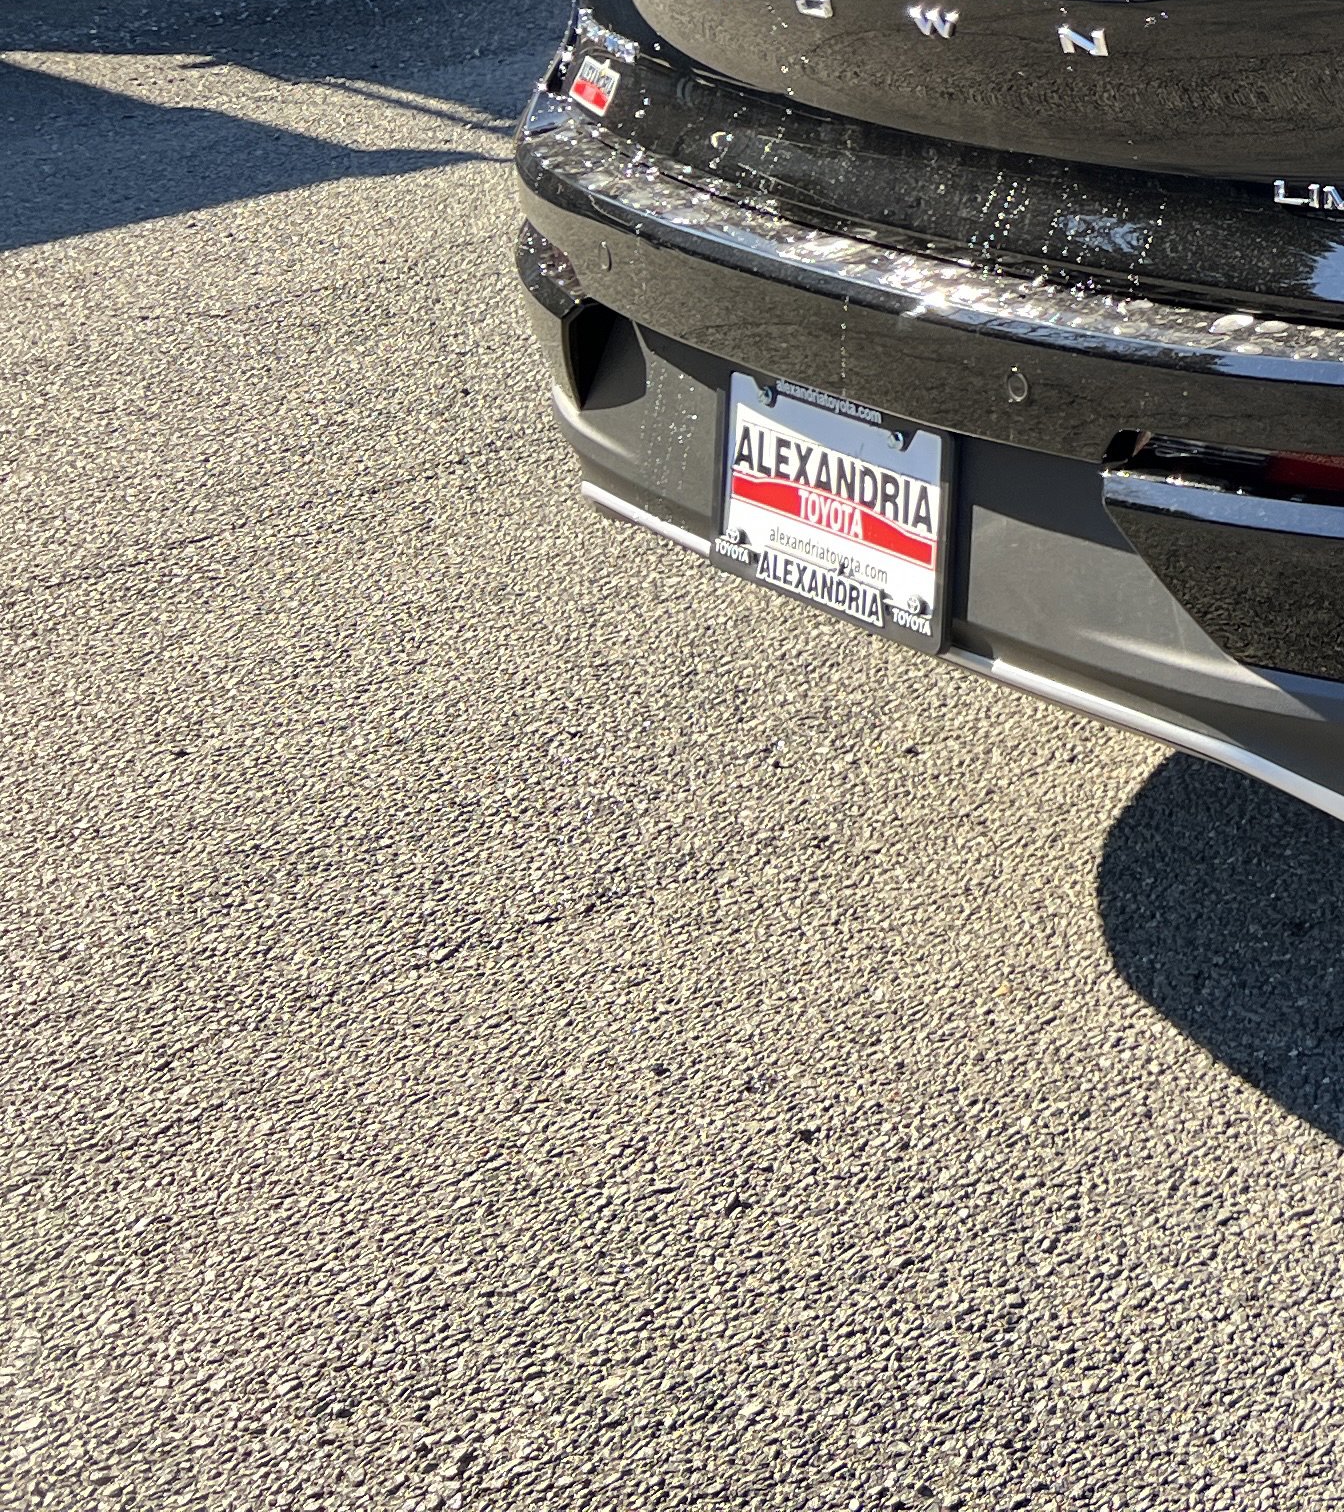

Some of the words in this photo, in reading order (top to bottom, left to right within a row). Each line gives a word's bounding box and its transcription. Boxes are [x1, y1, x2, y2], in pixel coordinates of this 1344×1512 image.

[775, 379, 882, 424] alexandriatoyota.com
[734, 425, 934, 535] ALEXANDRIA
[797, 489, 864, 539] TOYOTA
[714, 538, 750, 564] TOYOTA
[768, 527, 889, 585] alexandriatoyota.com
[757, 549, 884, 626] ALEXANDRIA
[891, 607, 932, 636] TOYOTA
